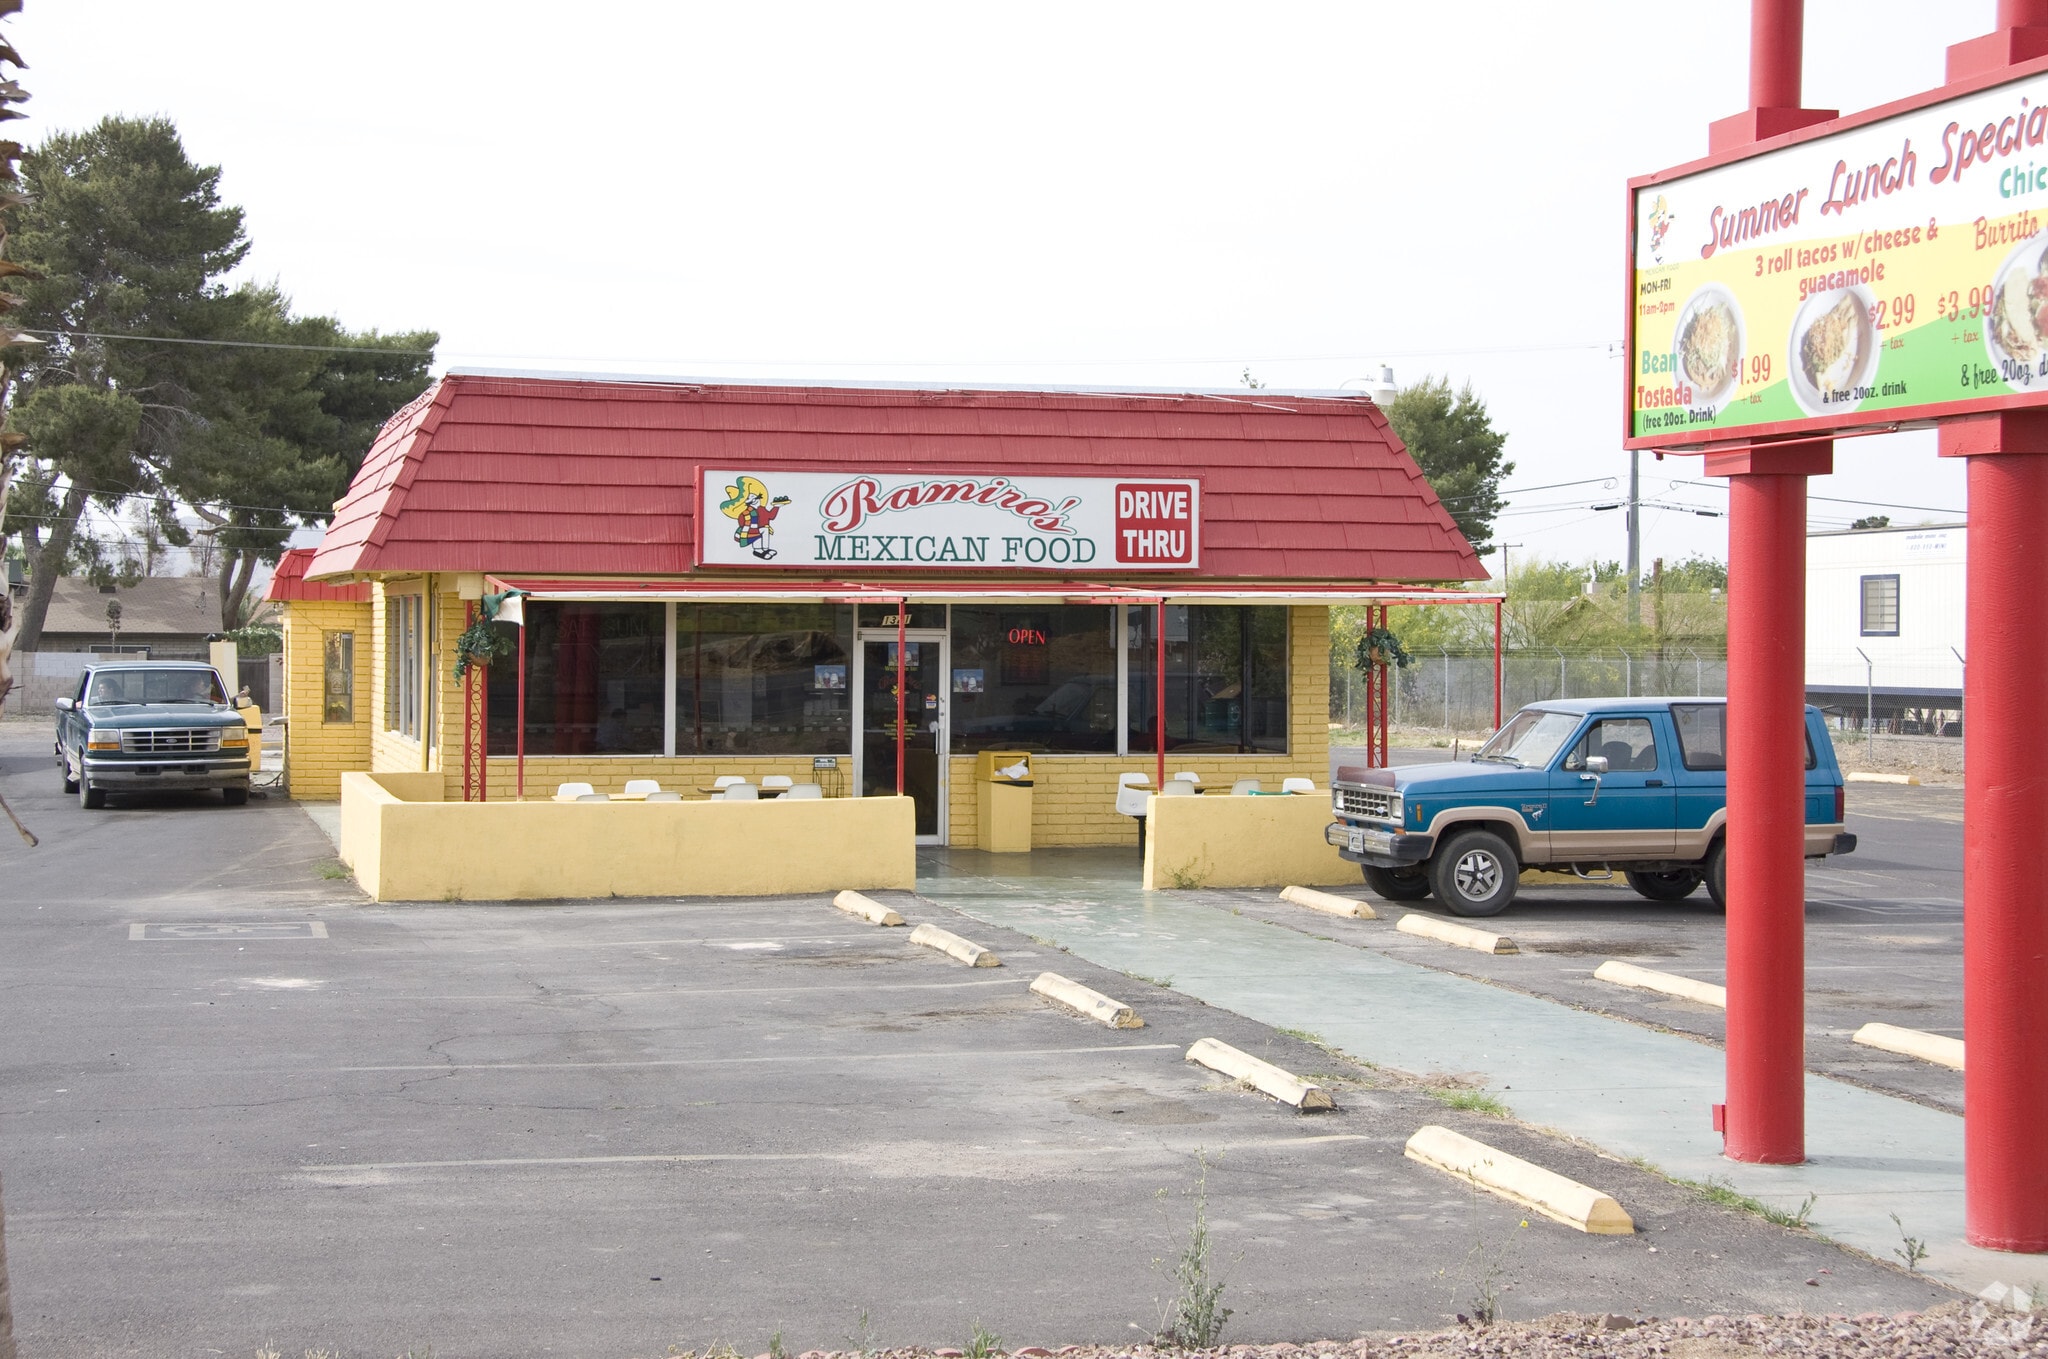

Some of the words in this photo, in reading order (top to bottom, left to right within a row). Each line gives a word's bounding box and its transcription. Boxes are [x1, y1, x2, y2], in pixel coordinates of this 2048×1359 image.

[1700, 187, 1809, 259] Summer
[1820, 138, 1917, 216] Lunch
[1929, 96, 2048, 185] Specia
[1973, 209, 2041, 251] Burrito
[1755, 255, 1764, 277] 3
[1767, 248, 1793, 275] roll
[1797, 243, 1837, 268] tacos
[1842, 225, 1921, 260] w/cheese
[1926, 217, 1939, 241] &
[1640, 278, 1672, 296] MON-FRI
[1799, 258, 1885, 301] guacamole
[1639, 301, 1675, 316] 11am-2pm
[1868, 293, 1915, 331] $2.99
[1938, 284, 1994, 322] $3.99
[1890, 336, 1905, 350] tax
[1963, 328, 1979, 344] tax
[1641, 350, 1678, 375] Bean
[1731, 353, 1771, 386] $1.99
[1961, 364, 1970, 387] &
[1974, 363, 1998, 390] free
[2001, 358, 2034, 386] 20oz.
[1637, 381, 1692, 409] Tostada
[1750, 392, 1762, 405] tax
[1822, 391, 1829, 403] &
[1832, 388, 1850, 402] free
[1853, 386, 1879, 400] 20oz.
[1881, 380, 1907, 396] drink
[1642, 413, 1662, 432] (free
[1663, 411, 1687, 426] 20oz.
[1688, 405, 1717, 424] Drink)
[822, 477, 1080, 533] Ramiro's
[1119, 490, 1188, 519] DRIVE
[814, 535, 989, 562] MEXICAN
[1001, 536, 1096, 563] FOOD
[1122, 529, 1186, 558] THRU
[884, 615, 911, 625] 131
[1008, 628, 1046, 645] OPEN
